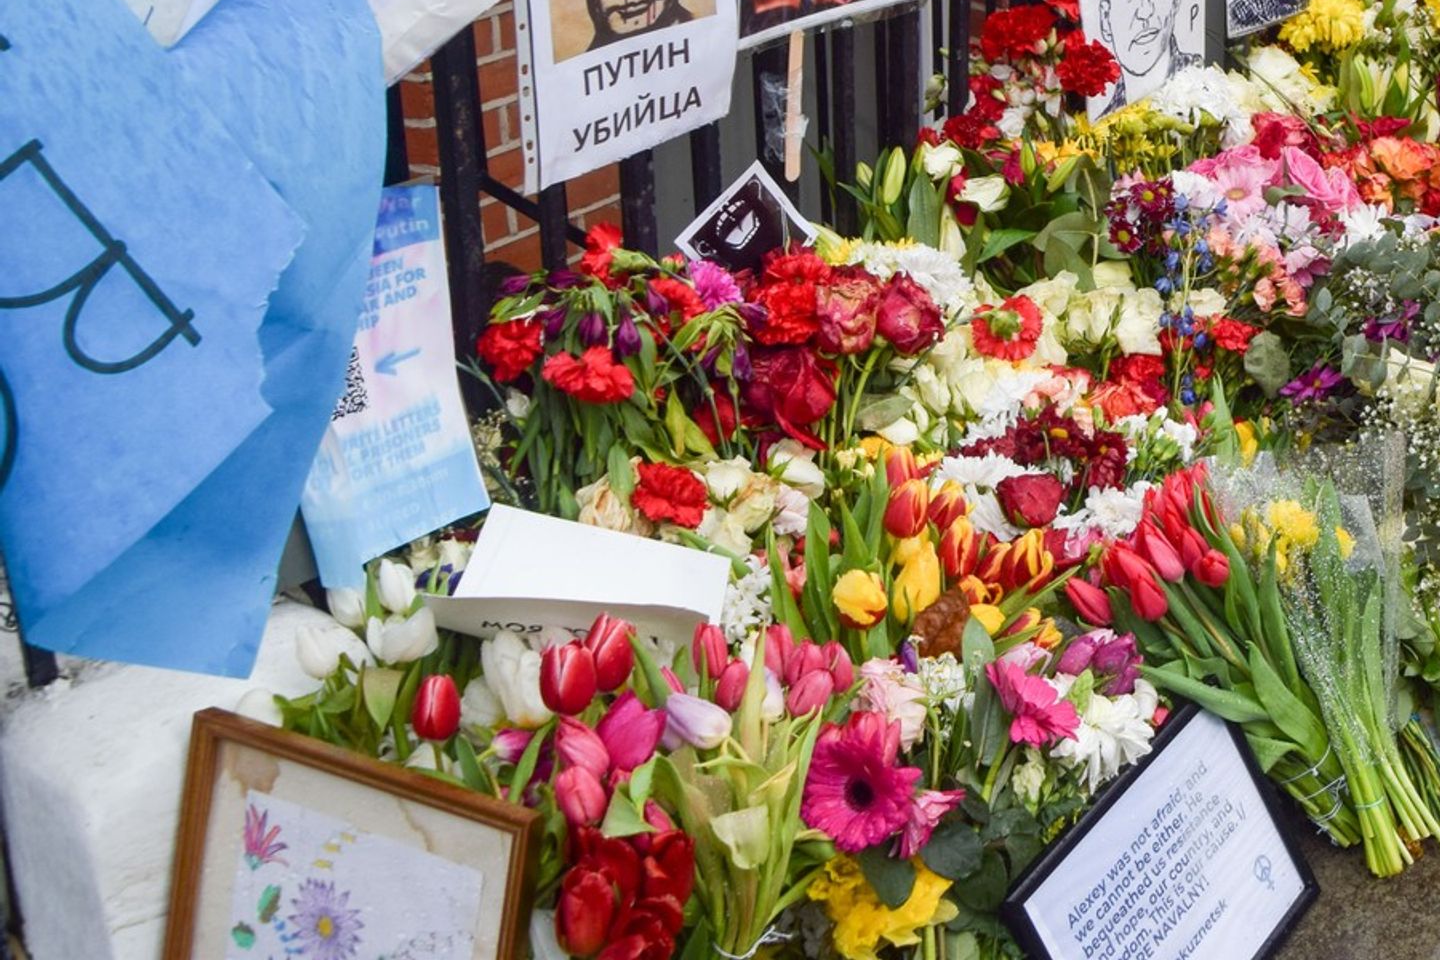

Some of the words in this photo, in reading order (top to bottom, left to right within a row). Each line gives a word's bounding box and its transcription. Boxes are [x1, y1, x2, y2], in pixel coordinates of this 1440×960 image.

[582, 37, 691, 97] ПУТИН
[572, 85, 703, 153] УБИЙЦА
[384, 285, 418, 308] AND
[395, 267, 428, 286] FOR
[1068, 879, 1107, 929] Alexey
[1107, 852, 1131, 881] was
[1131, 827, 1151, 853] not
[1152, 789, 1187, 830] afraid,
[1186, 761, 1208, 789] and
[1074, 920, 1095, 942] we
[1096, 870, 1135, 919] cannot
[1135, 851, 1151, 872] be
[1152, 814, 1187, 853] either.
[1186, 791, 1203, 812] He
[1082, 874, 1152, 959] bequeathed
[1151, 856, 1167, 876] us
[1165, 795, 1220, 861] resistance
[1096, 941, 1116, 960] nd
[1114, 907, 1150, 945] hope,
[1149, 878, 1168, 905] our
[1168, 830, 1213, 881] country,
[1212, 801, 1233, 828] and
[1149, 897, 1174, 925] This
[1174, 883, 1185, 898] is
[1185, 856, 1205, 884] our
[1205, 821, 1239, 860] cause.
[1153, 874, 1211, 948] NAVALNY!
